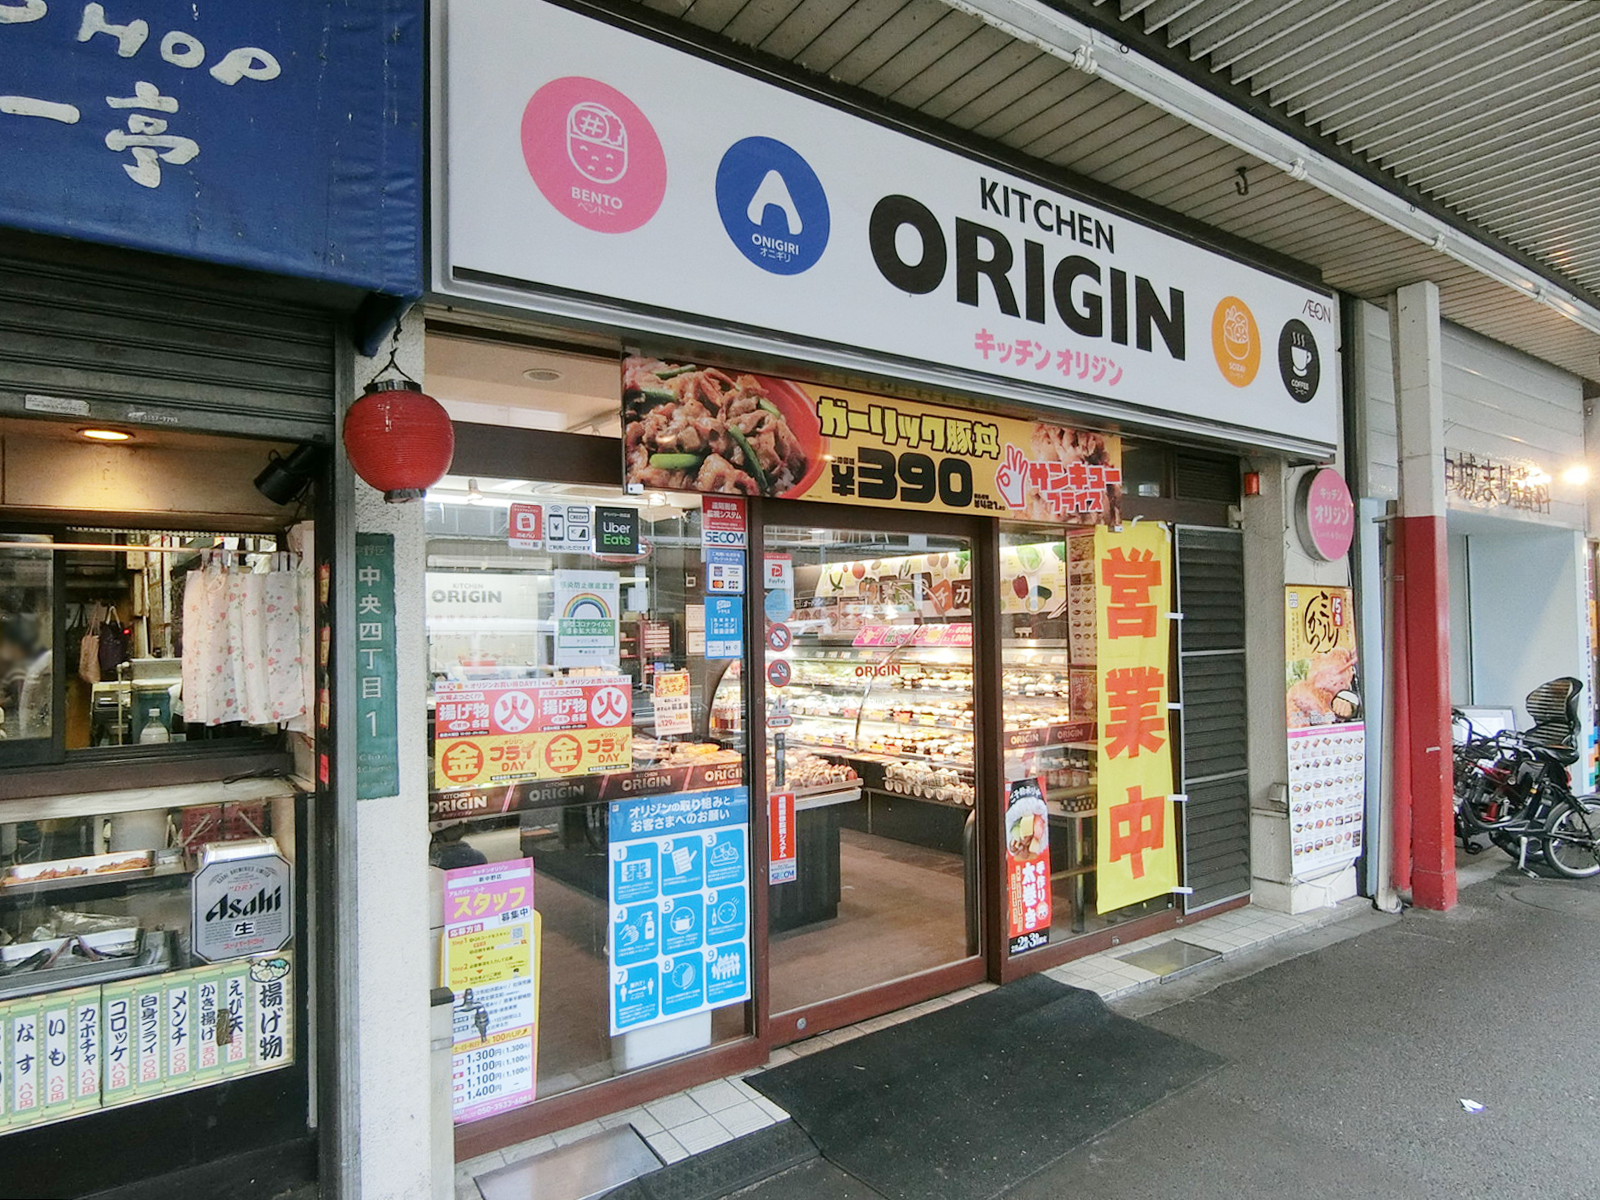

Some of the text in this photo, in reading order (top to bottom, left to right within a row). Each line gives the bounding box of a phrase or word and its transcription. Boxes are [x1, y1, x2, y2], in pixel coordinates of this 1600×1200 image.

[571, 186, 623, 210] BENTO
[577, 200, 616, 216] ベントー
[979, 176, 1115, 254] KITCHEN
[751, 233, 800, 256] ONIGIRI
[760, 246, 791, 263] オニギリ
[868, 194, 1186, 361] ORIGIN
[974, 328, 1123, 387] キッチンオリジン
[1291, 379, 1310, 391] COFFEE
[817, 397, 999, 459] ガーリック豚丼
[1029, 463, 1121, 491] サンキュー
[1320, 488, 1342, 501] キッチン
[1315, 504, 1349, 526] オリジン
[603, 521, 631, 534] Uber
[603, 534, 631, 546] Eats
[705, 531, 744, 544] SECOM
[431, 590, 502, 603] ORIGIN
[855, 665, 900, 677] ORIGIN
[439, 703, 489, 721] 揚げ物
[500, 695, 530, 725] 火
[543, 698, 587, 715] 揚げ物
[597, 691, 623, 720] 火
[1101, 546, 1167, 880] 営業中
[1010, 733, 1039, 745] ORIGIN
[501, 761, 526, 772] DAY
[598, 753, 620, 763] DAY
[621, 775, 672, 792] ORIGIN
[443, 791, 471, 799] KITCHEN
[529, 785, 585, 802] ORIGIN
[629, 796, 731, 819] オリジンの取り組みと
[631, 809, 730, 833] お客さまへのお願い
[663, 841, 670, 852] 2
[707, 834, 714, 846] 3
[618, 848, 622, 859] 1
[771, 869, 795, 881] SECOM
[205, 884, 282, 922] Asahi
[453, 886, 525, 919] スタッフ
[708, 892, 714, 902] 6
[501, 907, 529, 922] 募集中
[617, 910, 624, 921] 4
[664, 902, 671, 912] 5
[234, 922, 255, 936] 生
[708, 950, 714, 961] 9
[664, 960, 670, 971] 8
[617, 971, 624, 983] 7
[171, 990, 187, 1046] メンチ
[200, 984, 216, 1041] かき揚げ
[259, 981, 284, 1061] 揚げ物
[109, 1000, 128, 1061] コロッケ
[140, 995, 158, 1054] 白身フライ
[49, 1018, 66, 1067] いも
[80, 1007, 96, 1066] カボチャ
[16, 1023, 35, 1076] なす
